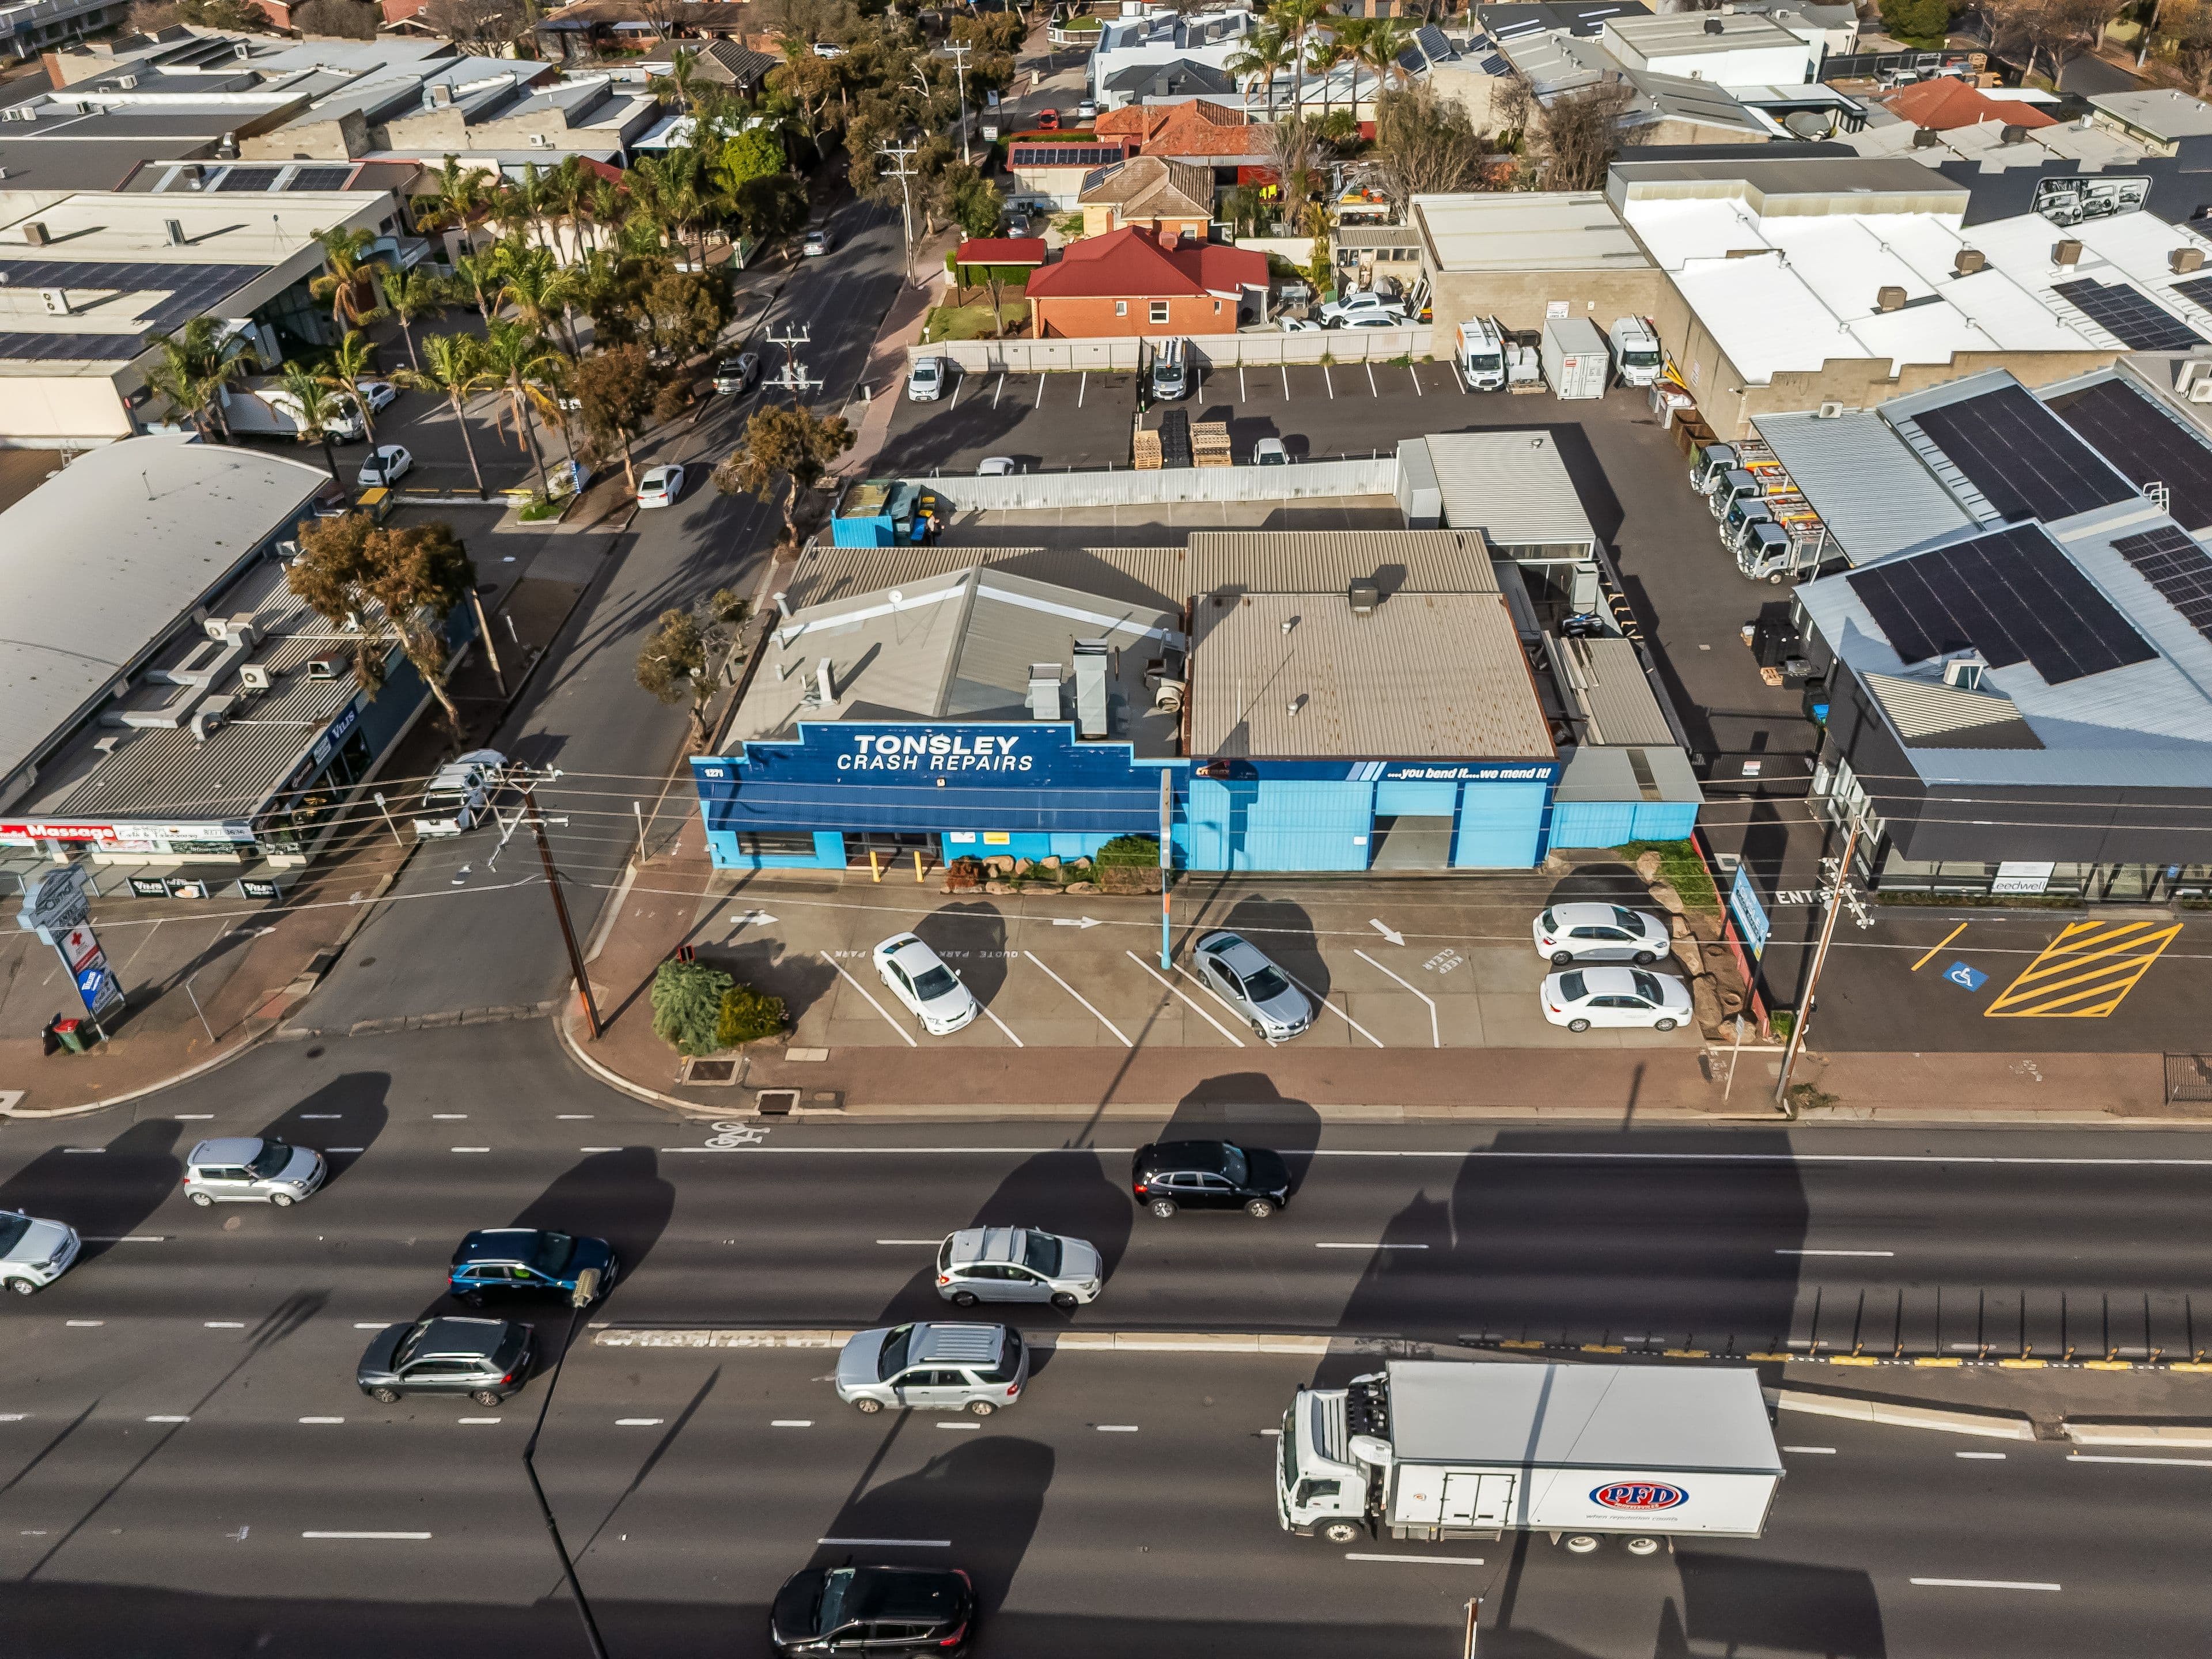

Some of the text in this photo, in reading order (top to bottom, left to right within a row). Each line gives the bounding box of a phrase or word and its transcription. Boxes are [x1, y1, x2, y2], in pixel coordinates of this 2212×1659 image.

[854, 734, 1020, 755] TONSLEY
[837, 755, 1033, 771] CRASH REPAIRS
[1426, 768, 1457, 779] bend
[1499, 768, 1536, 779] mend
[26, 824, 115, 840] Massage
[1993, 881, 2046, 891] eedwell
[1775, 890, 1822, 904] ENT
[835, 950, 866, 958] PARK
[1422, 948, 1454, 970] CLEAR
[1439, 955, 1464, 974] KEEP
[1605, 1486, 1676, 1505] PFD
